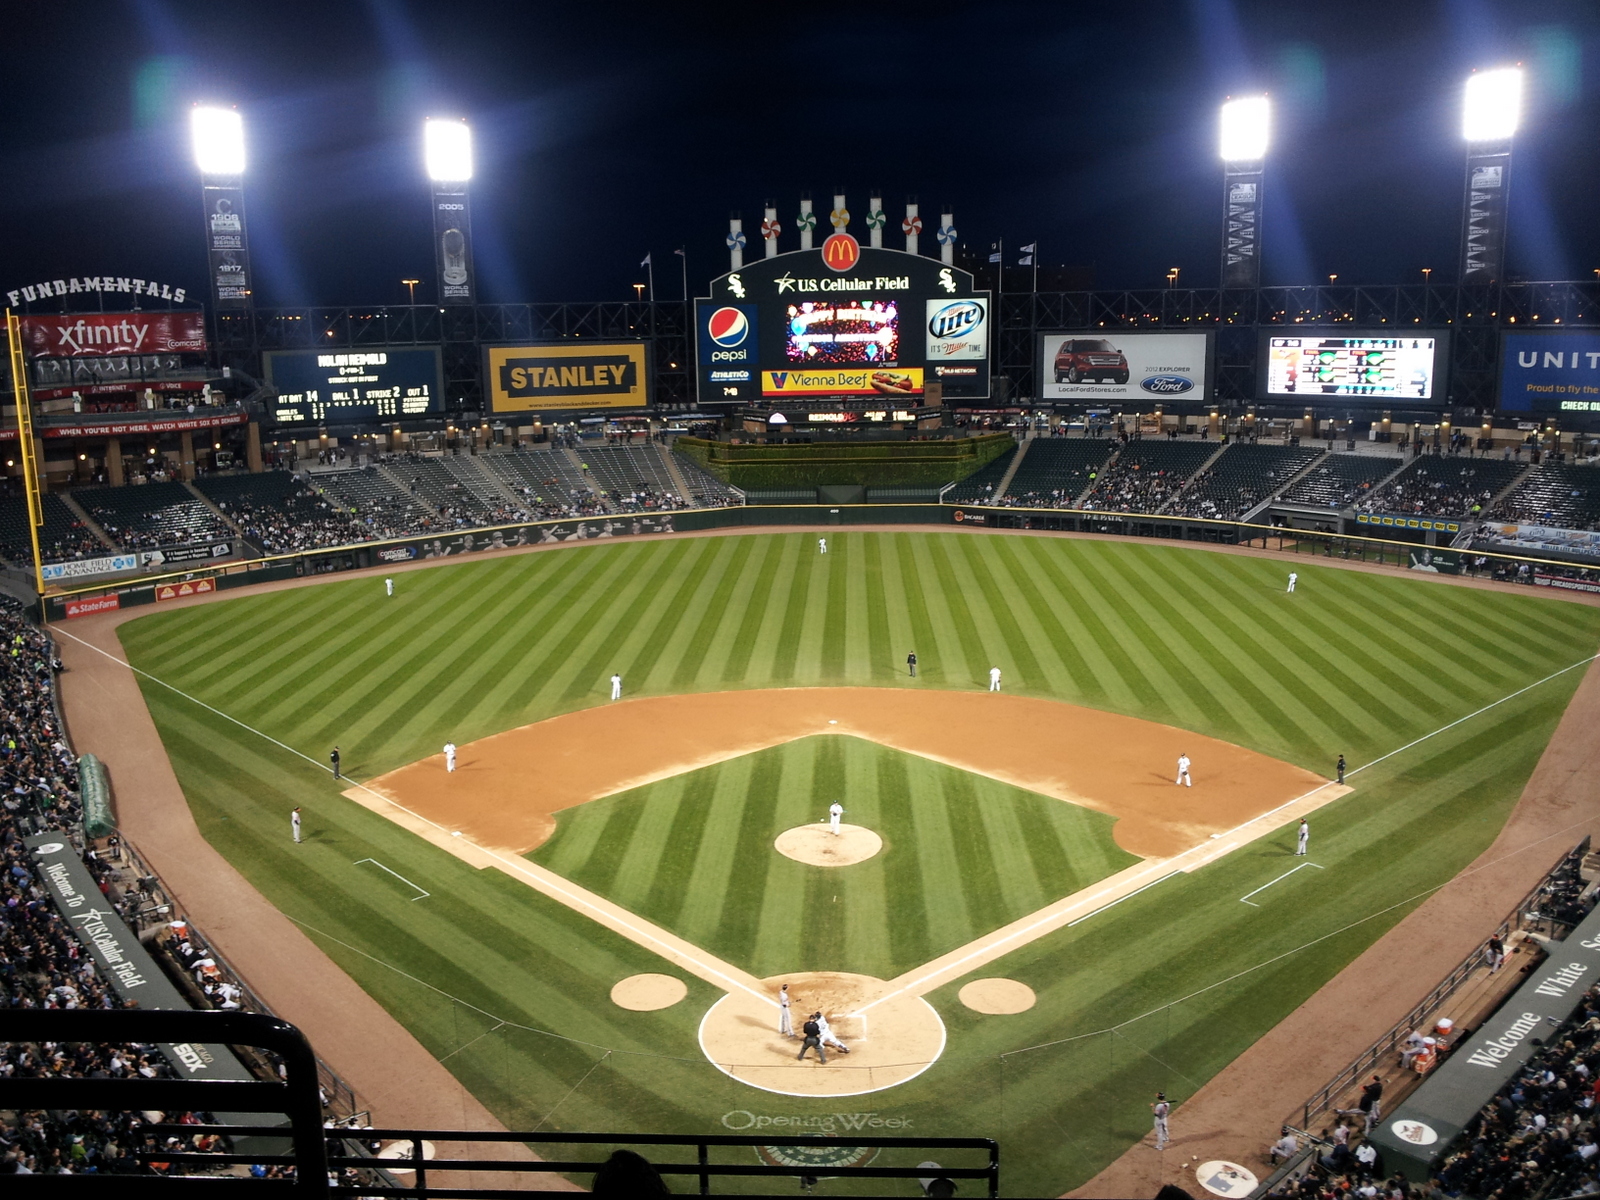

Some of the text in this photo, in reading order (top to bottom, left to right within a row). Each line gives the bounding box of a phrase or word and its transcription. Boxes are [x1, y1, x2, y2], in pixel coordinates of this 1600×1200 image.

[820, 276, 873, 291] Cellular
[875, 276, 910, 290] Field
[7, 276, 186, 308] FUNDAMENTALS
[937, 307, 978, 339] Lite
[57, 320, 149, 351] xfinity
[167, 339, 201, 349] comcast
[930, 342, 981, 356] IT'S Miller TIME
[711, 349, 747, 362] pepsi
[511, 364, 627, 389] STANLEY
[792, 372, 867, 388] Vienna Beef
[1151, 377, 1184, 392] Ford
[289, 394, 303, 403] BAT
[306, 390, 319, 402] 14
[332, 392, 350, 401] BALL
[353, 388, 360, 400] 1
[366, 389, 392, 399] STRIKE
[392, 386, 400, 398] 2
[407, 388, 421, 397] OUT
[422, 384, 429, 396] 1
[1526, 384, 1599, 394] Proud to fly the
[1561, 401, 1589, 411] CHECK
[84, 427, 110, 435] YOU'RE
[152, 423, 176, 431] WATCH
[178, 421, 198, 429] WHITE
[380, 547, 407, 557] comcast
[63, 558, 112, 570] HOME FIELD
[63, 565, 111, 576] ADVANTAGE
[46, 862, 86, 908] Welcome To
[91, 932, 124, 964] Cellular
[111, 960, 147, 989] Field
[1534, 962, 1588, 997] White
[1466, 1011, 1542, 1069] Welcome
[173, 1043, 208, 1073] SOX
[721, 1110, 914, 1132] Opening Week
